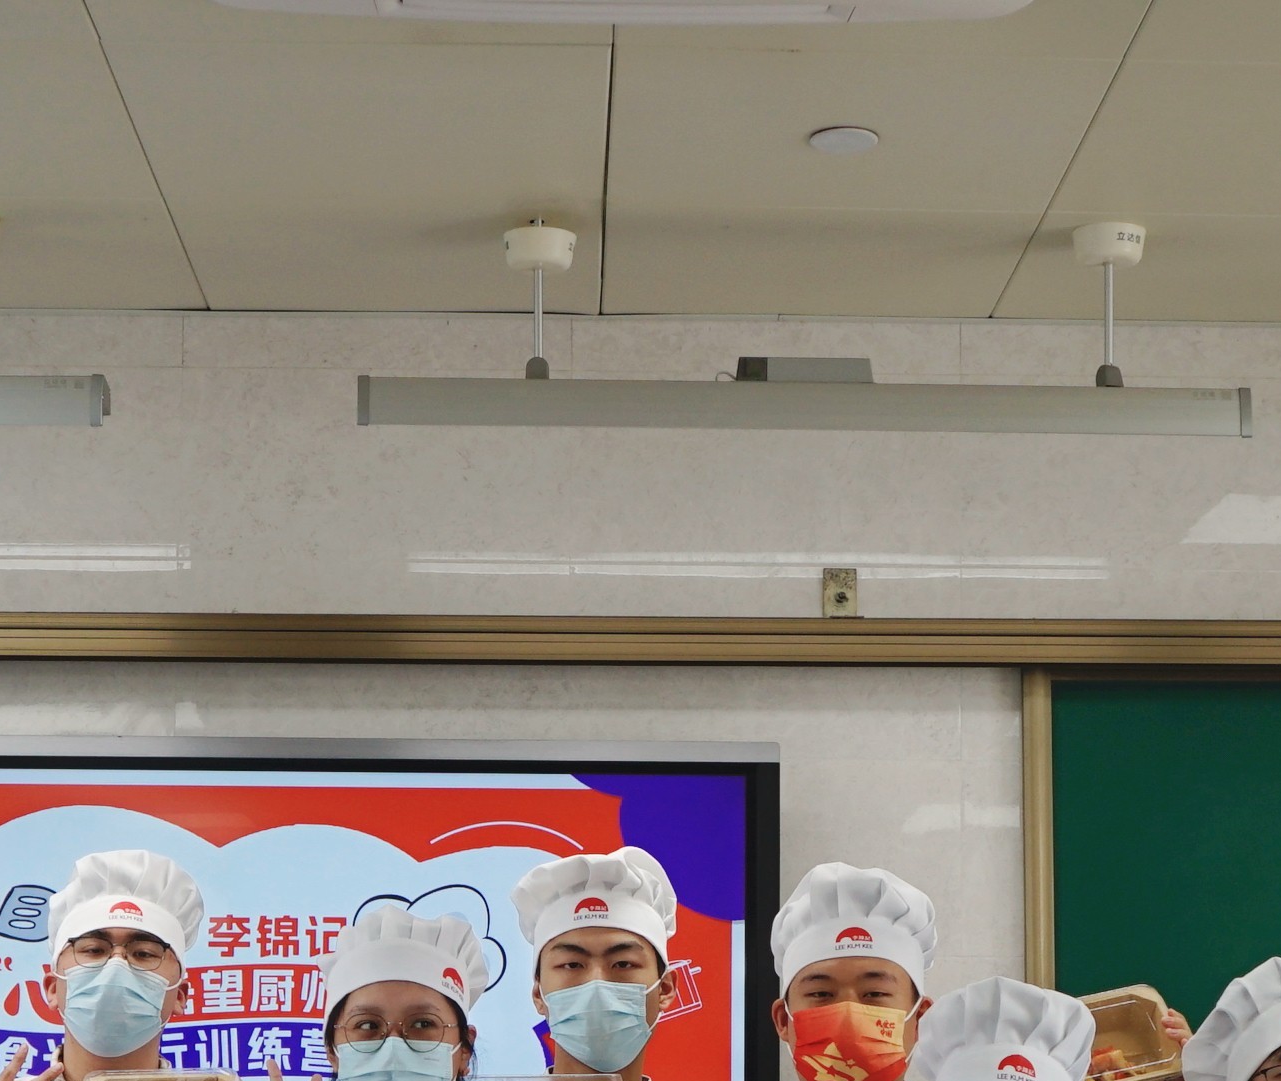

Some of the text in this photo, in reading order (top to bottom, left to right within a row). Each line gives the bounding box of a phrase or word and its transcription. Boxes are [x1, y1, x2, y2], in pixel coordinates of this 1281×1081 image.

[1116, 232, 1141, 244] 立达信
[209, 914, 347, 958] 李锦记
